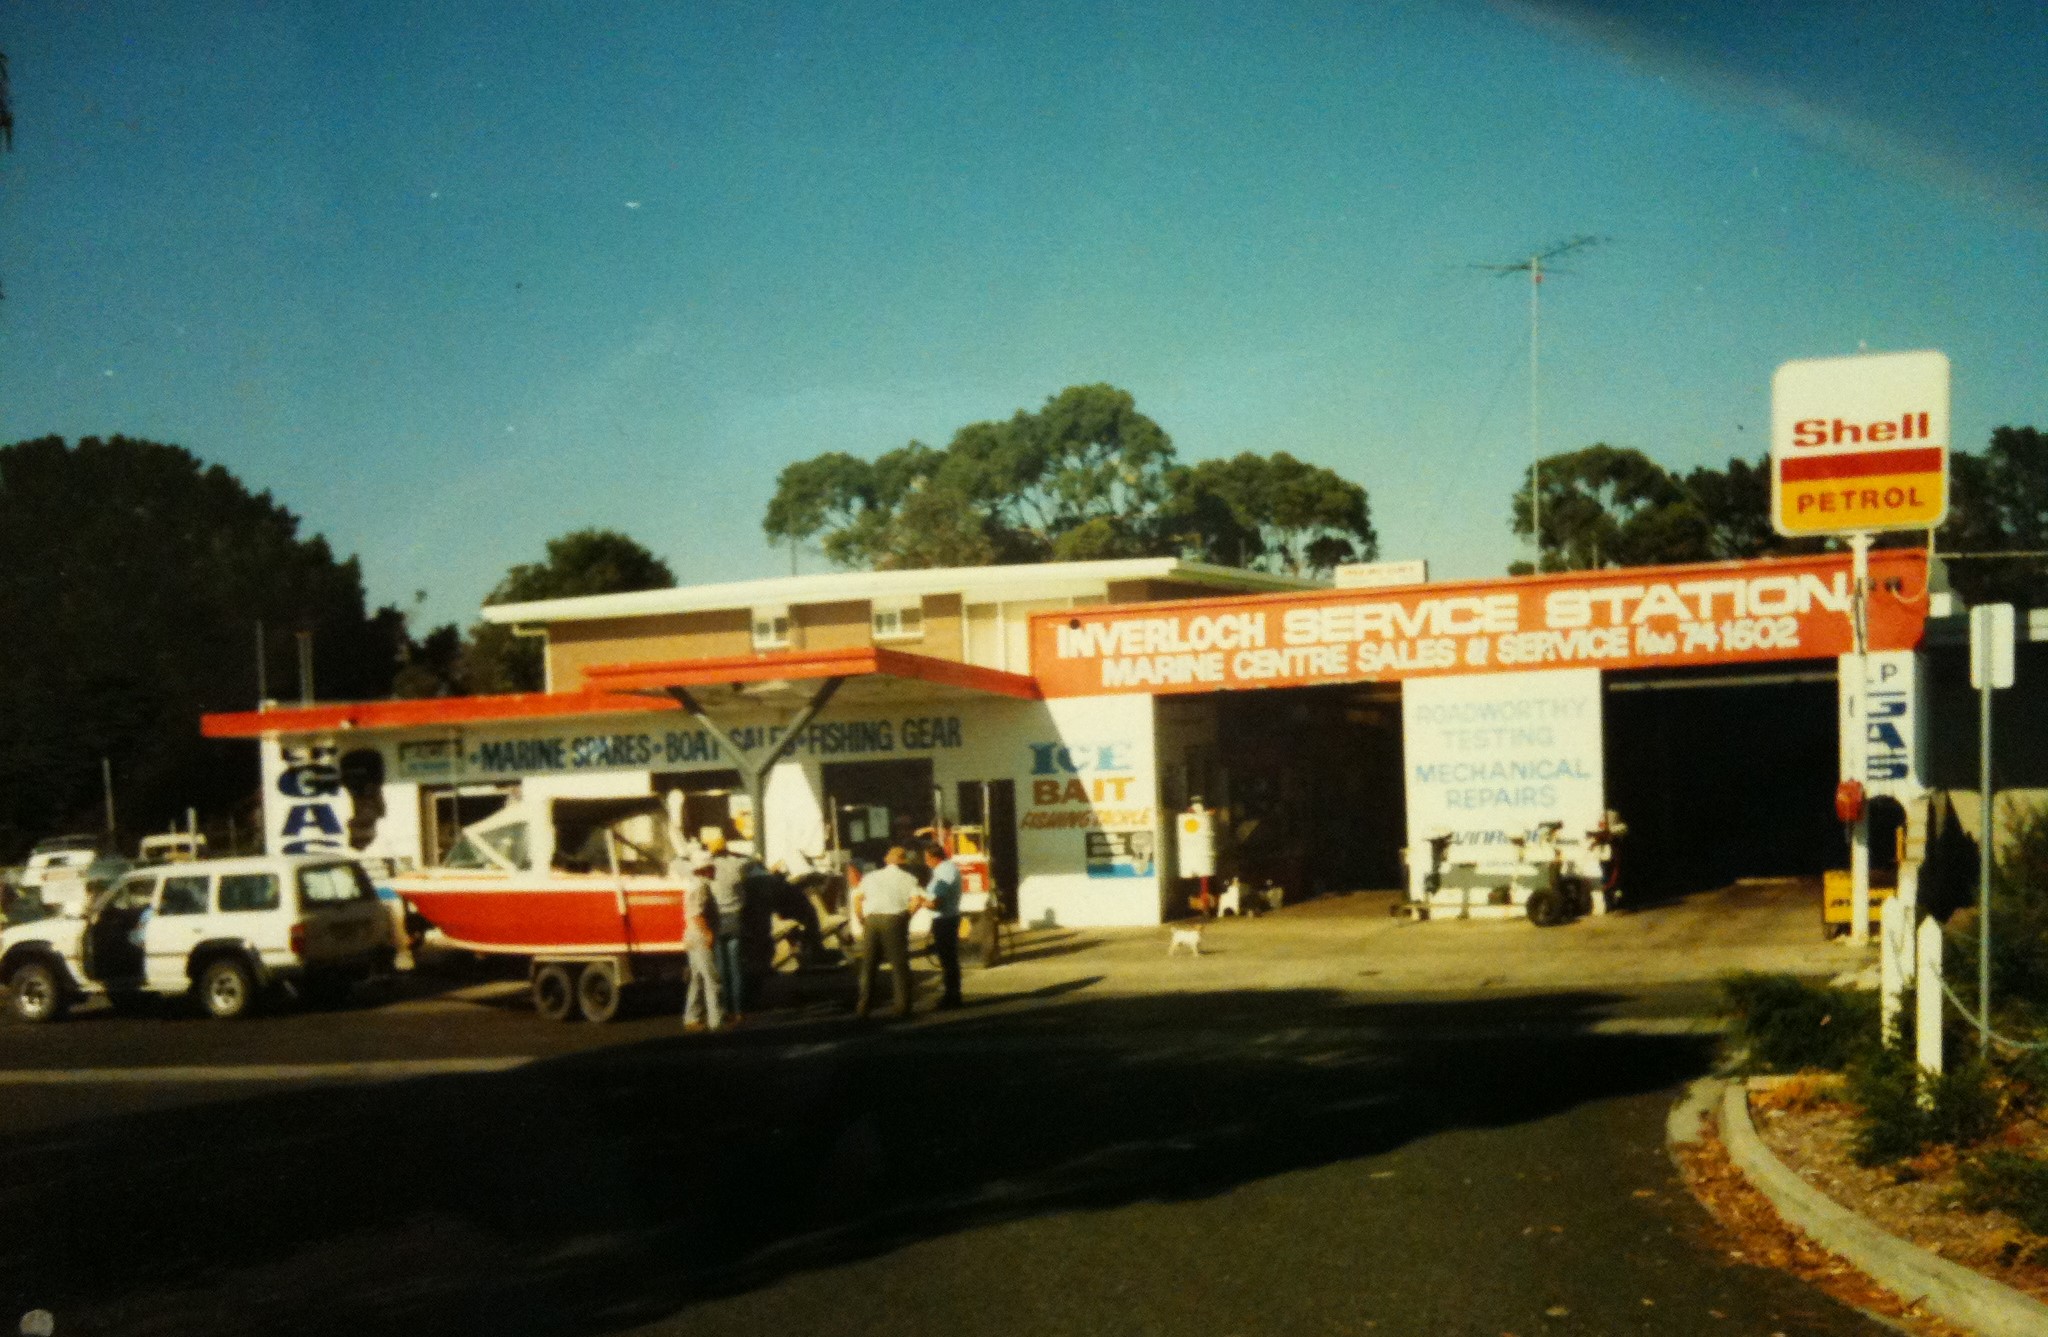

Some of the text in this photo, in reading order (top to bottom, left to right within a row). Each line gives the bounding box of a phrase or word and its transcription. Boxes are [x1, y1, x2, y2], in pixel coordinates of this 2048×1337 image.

[1793, 412, 1929, 448] Shell
[1797, 487, 1924, 514] PETROL
[1057, 571, 1850, 659] INVERLOCH SERVICE STATION
[1102, 653, 1225, 687] MARINE
[1233, 645, 1348, 679] CENTRE
[1356, 638, 1456, 672] SALES
[1497, 626, 1628, 665] SERVICE
[1415, 697, 1587, 724] ROADWORTHY
[480, 737, 566, 772] MARINE
[572, 733, 650, 768] SPARES
[810, 719, 895, 755] FISHING
[903, 716, 963, 750] GEAR
[1442, 725, 1555, 750] TESTING
[1415, 758, 1590, 783] MECHANICAL
[1033, 777, 1136, 806] BAIT
[1446, 785, 1557, 810] REPAIRS
